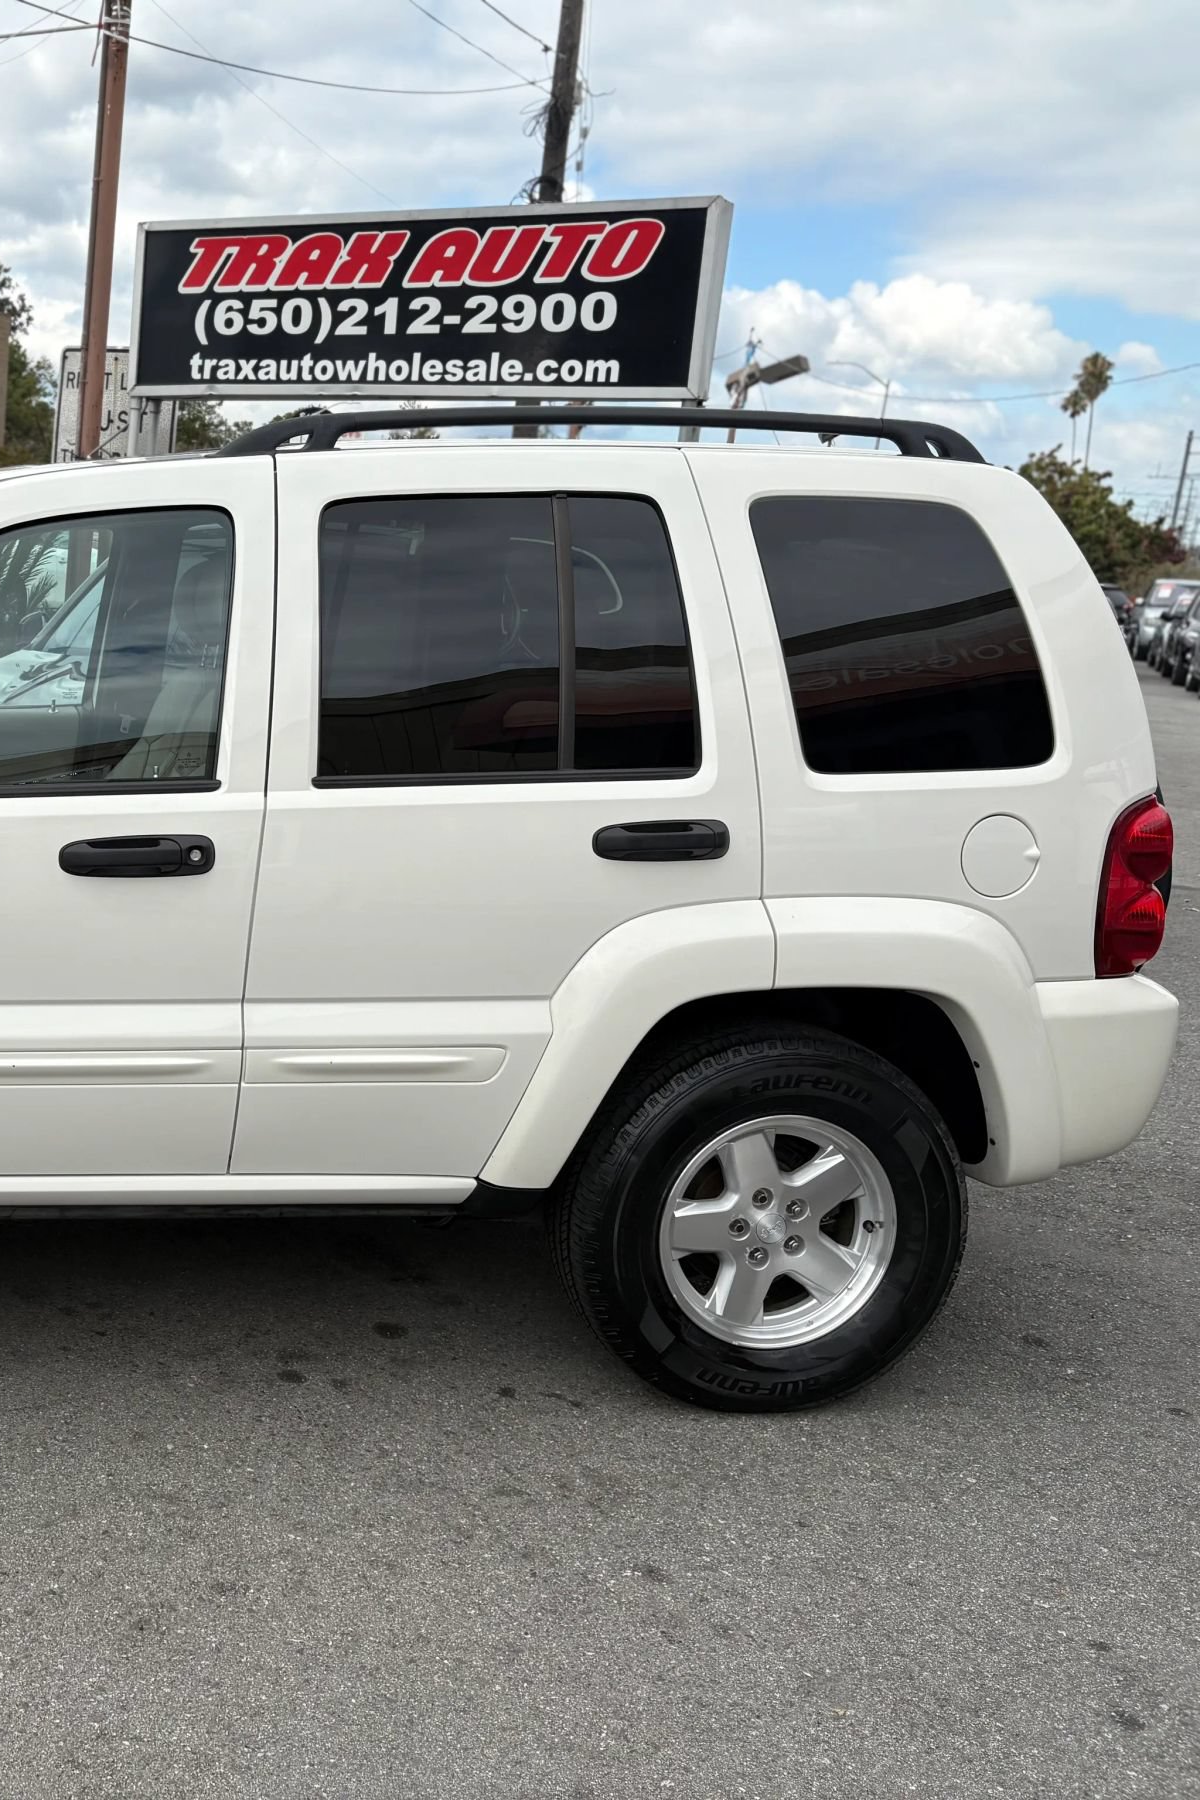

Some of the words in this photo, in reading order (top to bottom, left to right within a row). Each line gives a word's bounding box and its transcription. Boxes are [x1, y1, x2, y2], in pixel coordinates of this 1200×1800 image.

[178, 230, 410, 294] TRAX
[402, 218, 665, 288] AUTO
[194, 291, 618, 345] (650)212-2900
[190, 352, 620, 383] traxautowholesale.com
